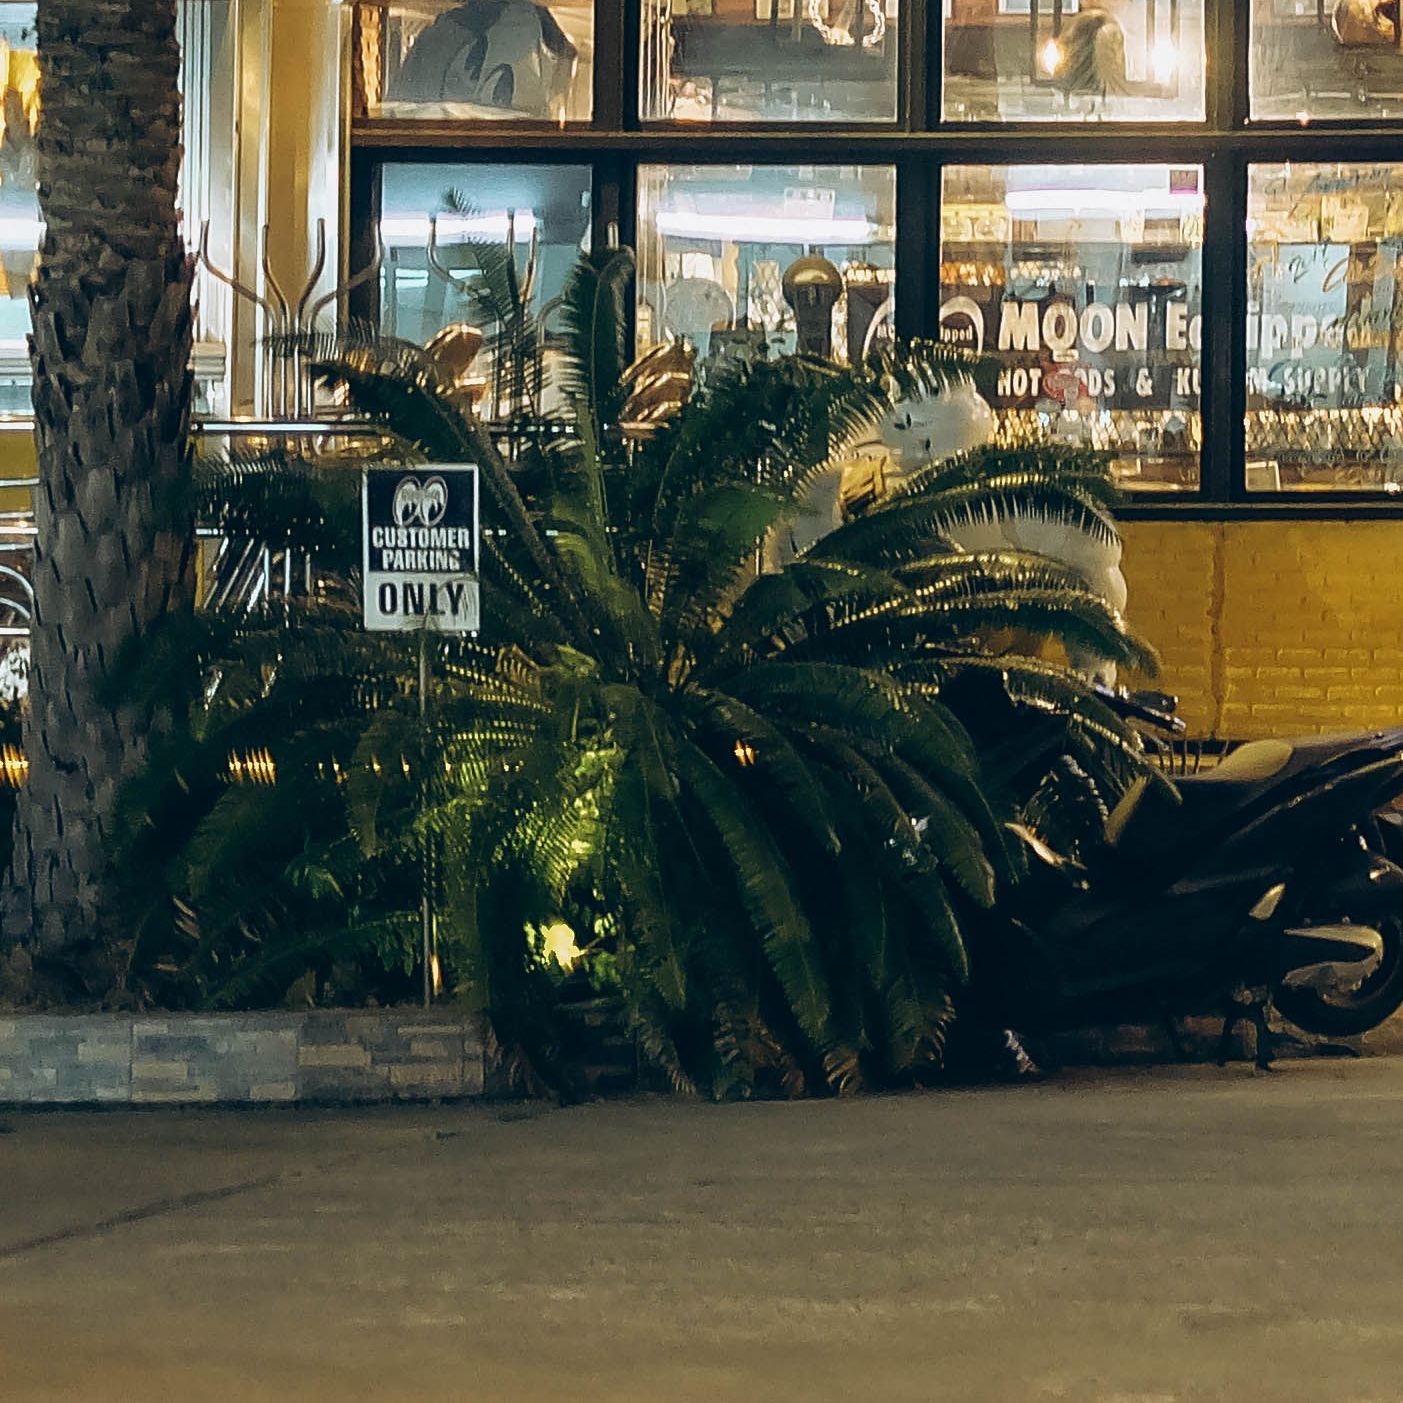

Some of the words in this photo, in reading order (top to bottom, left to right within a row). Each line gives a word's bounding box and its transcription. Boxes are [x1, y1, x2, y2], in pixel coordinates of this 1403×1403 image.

[997, 367, 1042, 397] HOT
[1135, 367, 1153, 398] &
[372, 526, 470, 549] CUSTOMER
[382, 549, 461, 571] PARKING
[378, 582, 465, 616] ONLY
